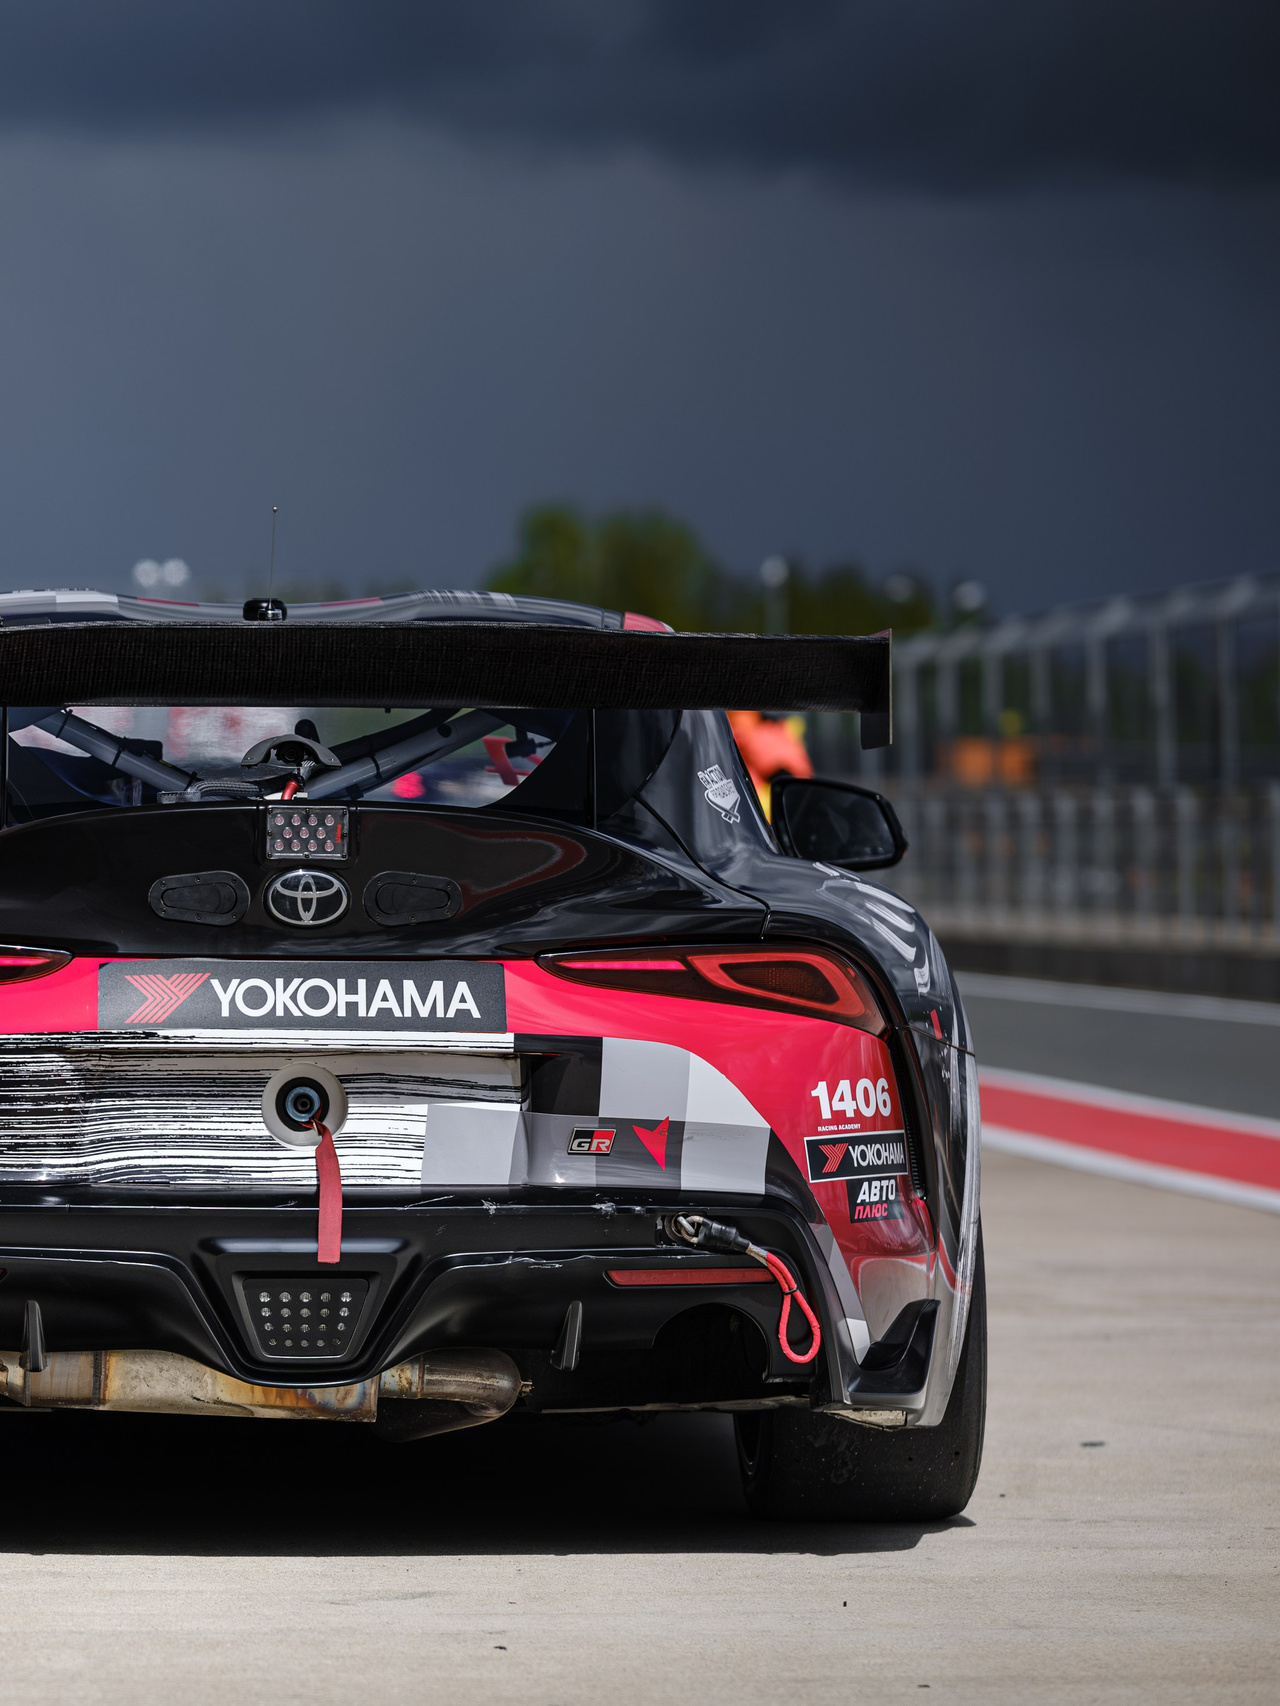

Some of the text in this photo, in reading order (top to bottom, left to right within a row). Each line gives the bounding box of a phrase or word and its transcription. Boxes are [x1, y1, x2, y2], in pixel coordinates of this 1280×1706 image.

[210, 977, 481, 1019] YOKOHAMA
[810, 1077, 892, 1120] 1406
[817, 1124, 838, 1132] RACING
[572, 1138, 610, 1151] GR
[848, 1142, 905, 1168] YOKOHAMA
[856, 1179, 896, 1204] АВТО
[854, 1204, 888, 1220] ПЛЮС
